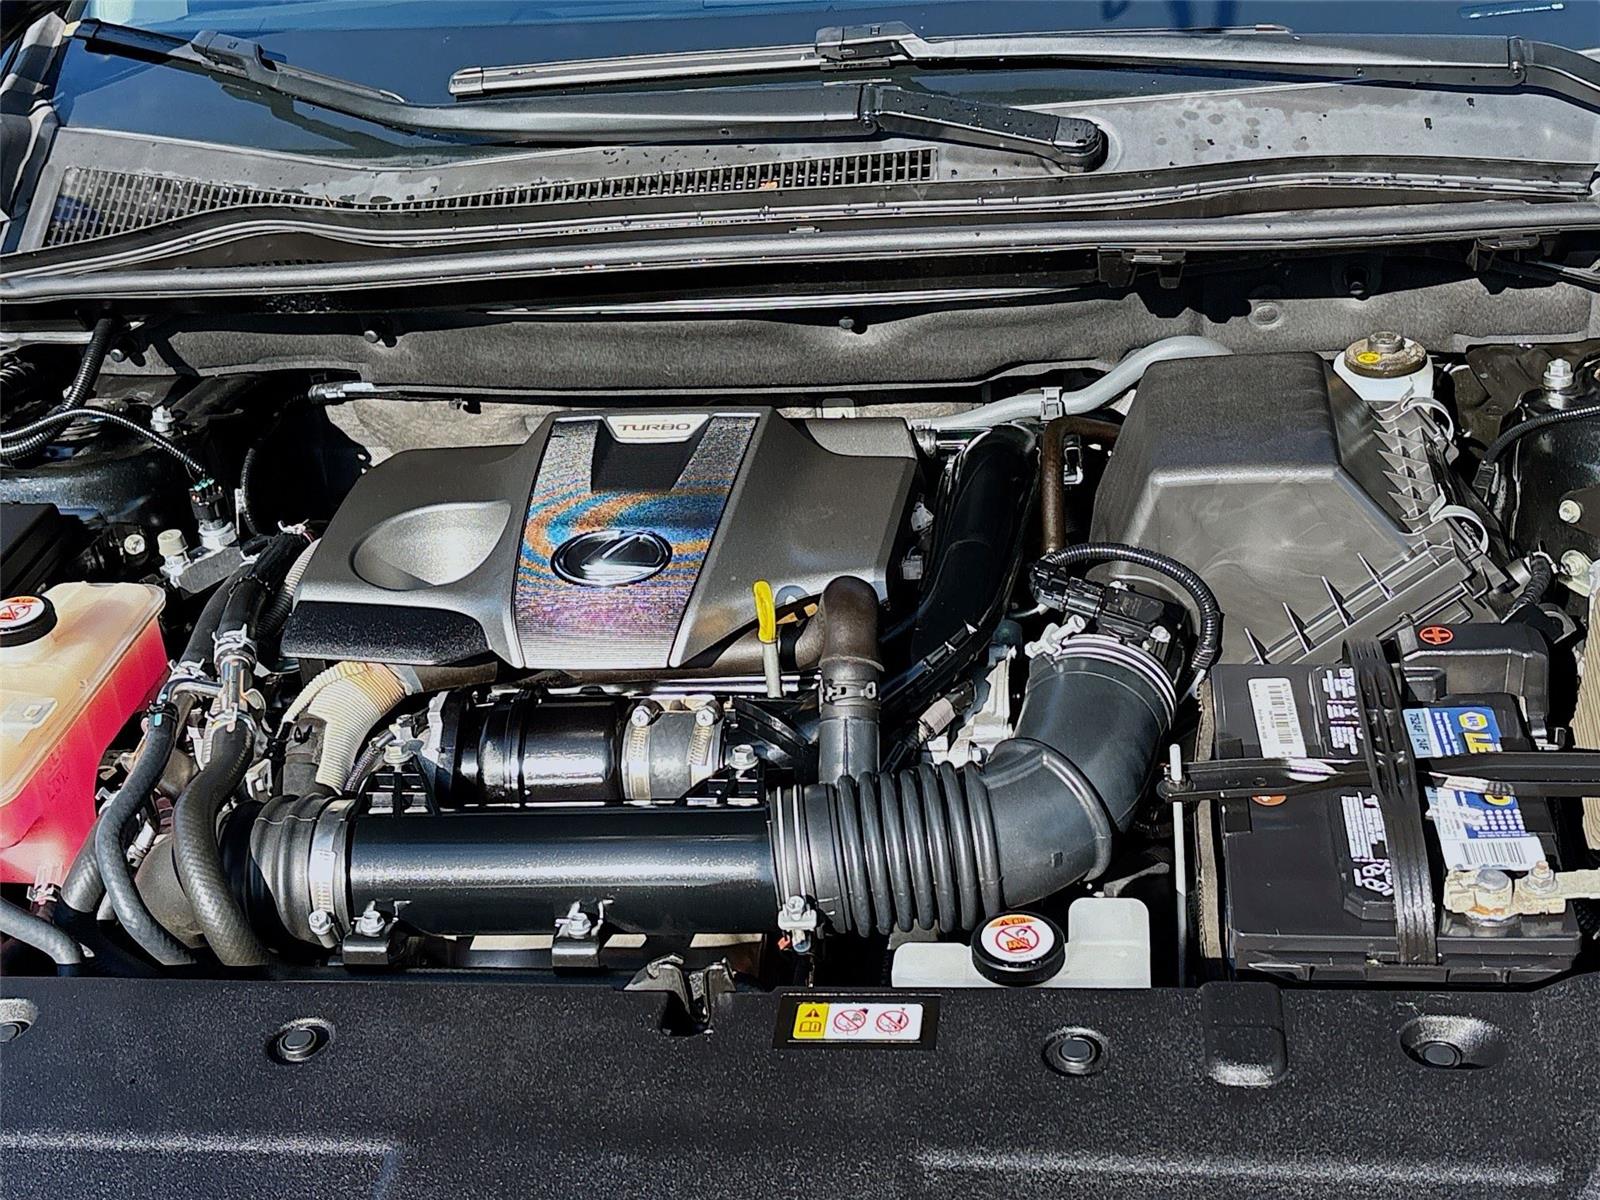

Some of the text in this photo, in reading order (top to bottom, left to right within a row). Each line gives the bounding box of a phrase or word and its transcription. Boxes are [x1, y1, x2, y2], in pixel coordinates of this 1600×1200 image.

[618, 422, 691, 431] TURBO
[1409, 713, 1424, 733] 7524F
[1416, 737, 1429, 751] 24F
